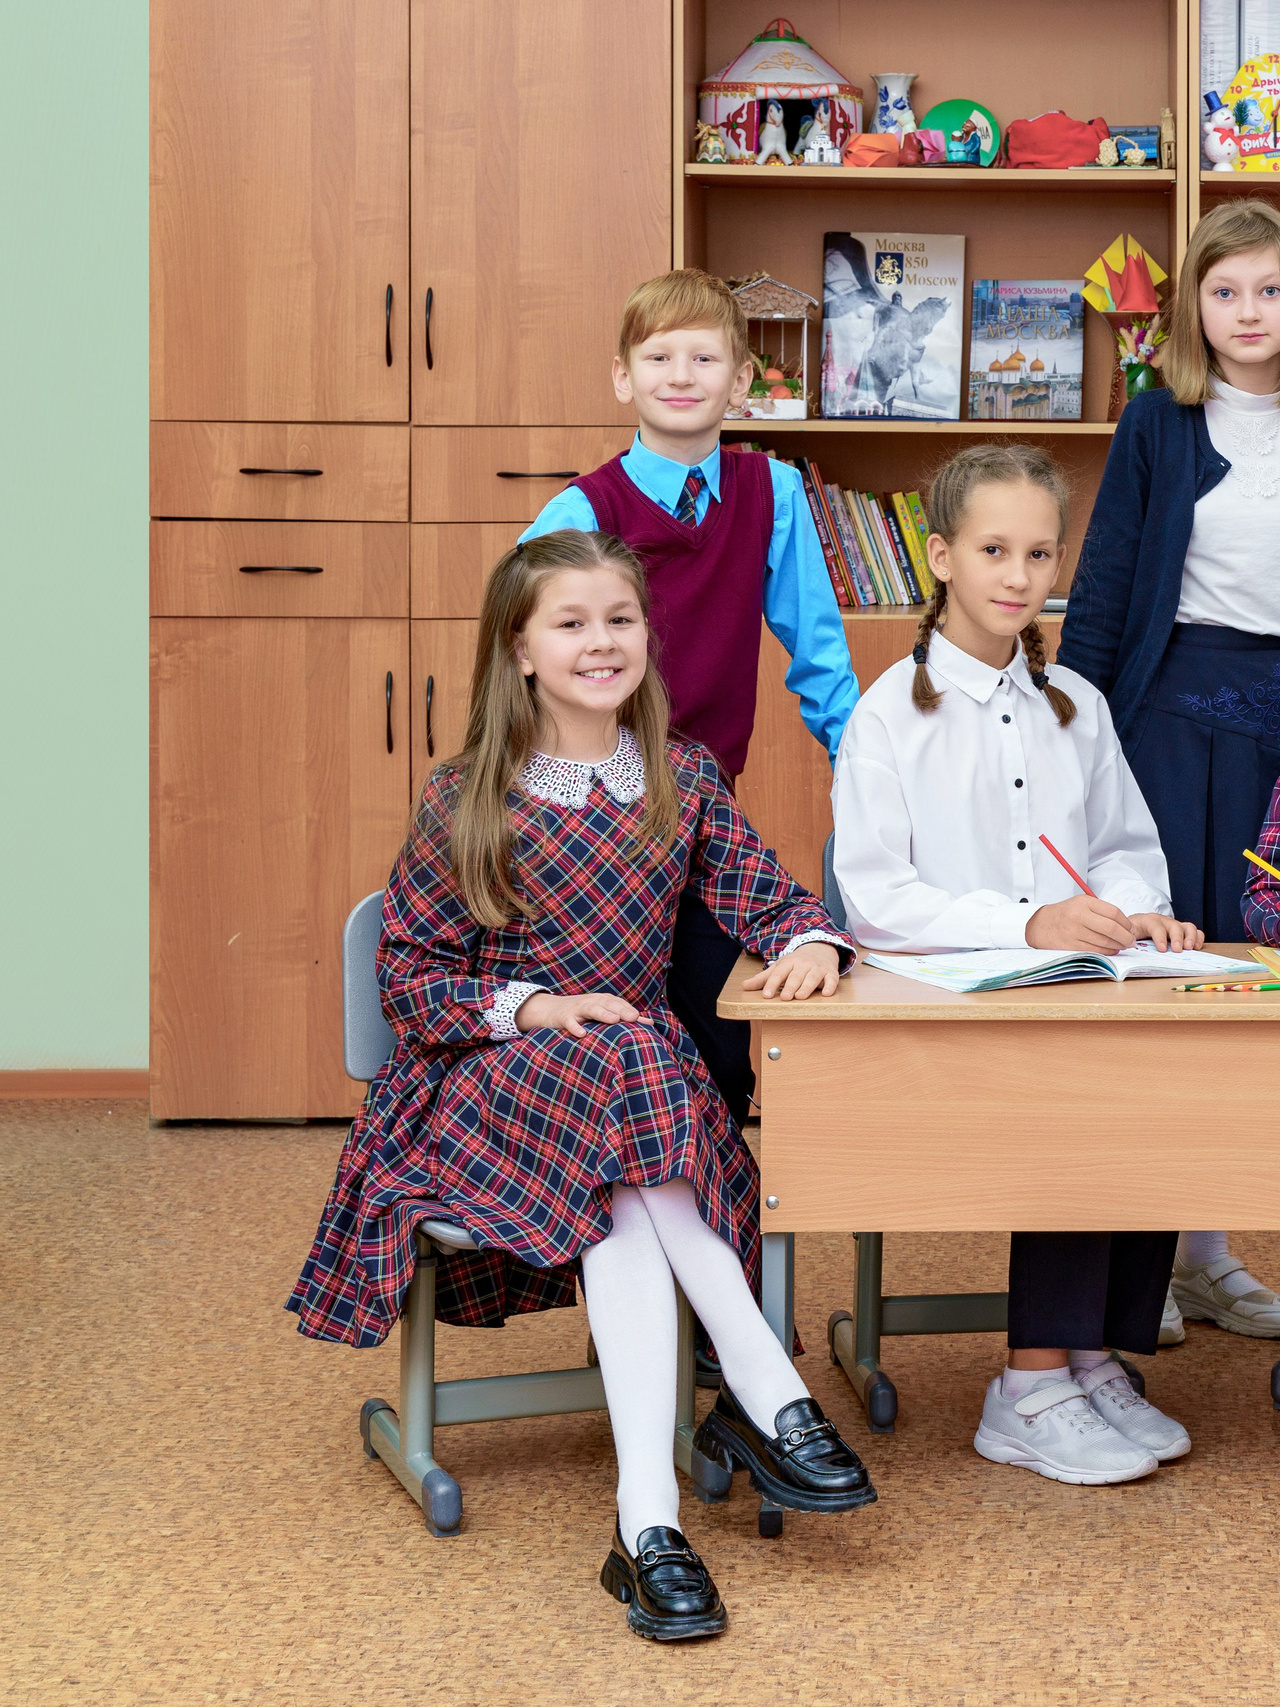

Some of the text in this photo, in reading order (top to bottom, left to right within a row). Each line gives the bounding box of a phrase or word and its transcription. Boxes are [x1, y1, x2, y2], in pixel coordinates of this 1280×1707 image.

[1268, 54, 1280, 64] 12
[1244, 65, 1255, 73] 11
[1230, 85, 1243, 94] 10
[1240, 161, 1247, 170] 7
[1272, 162, 1279, 171] 6
[905, 256, 929, 269] 850
[990, 287, 1068, 295] ЛАРИСА КУЗЬМИНА
[998, 306, 1059, 322] НАША
[985, 323, 1071, 340] МОСКВА
